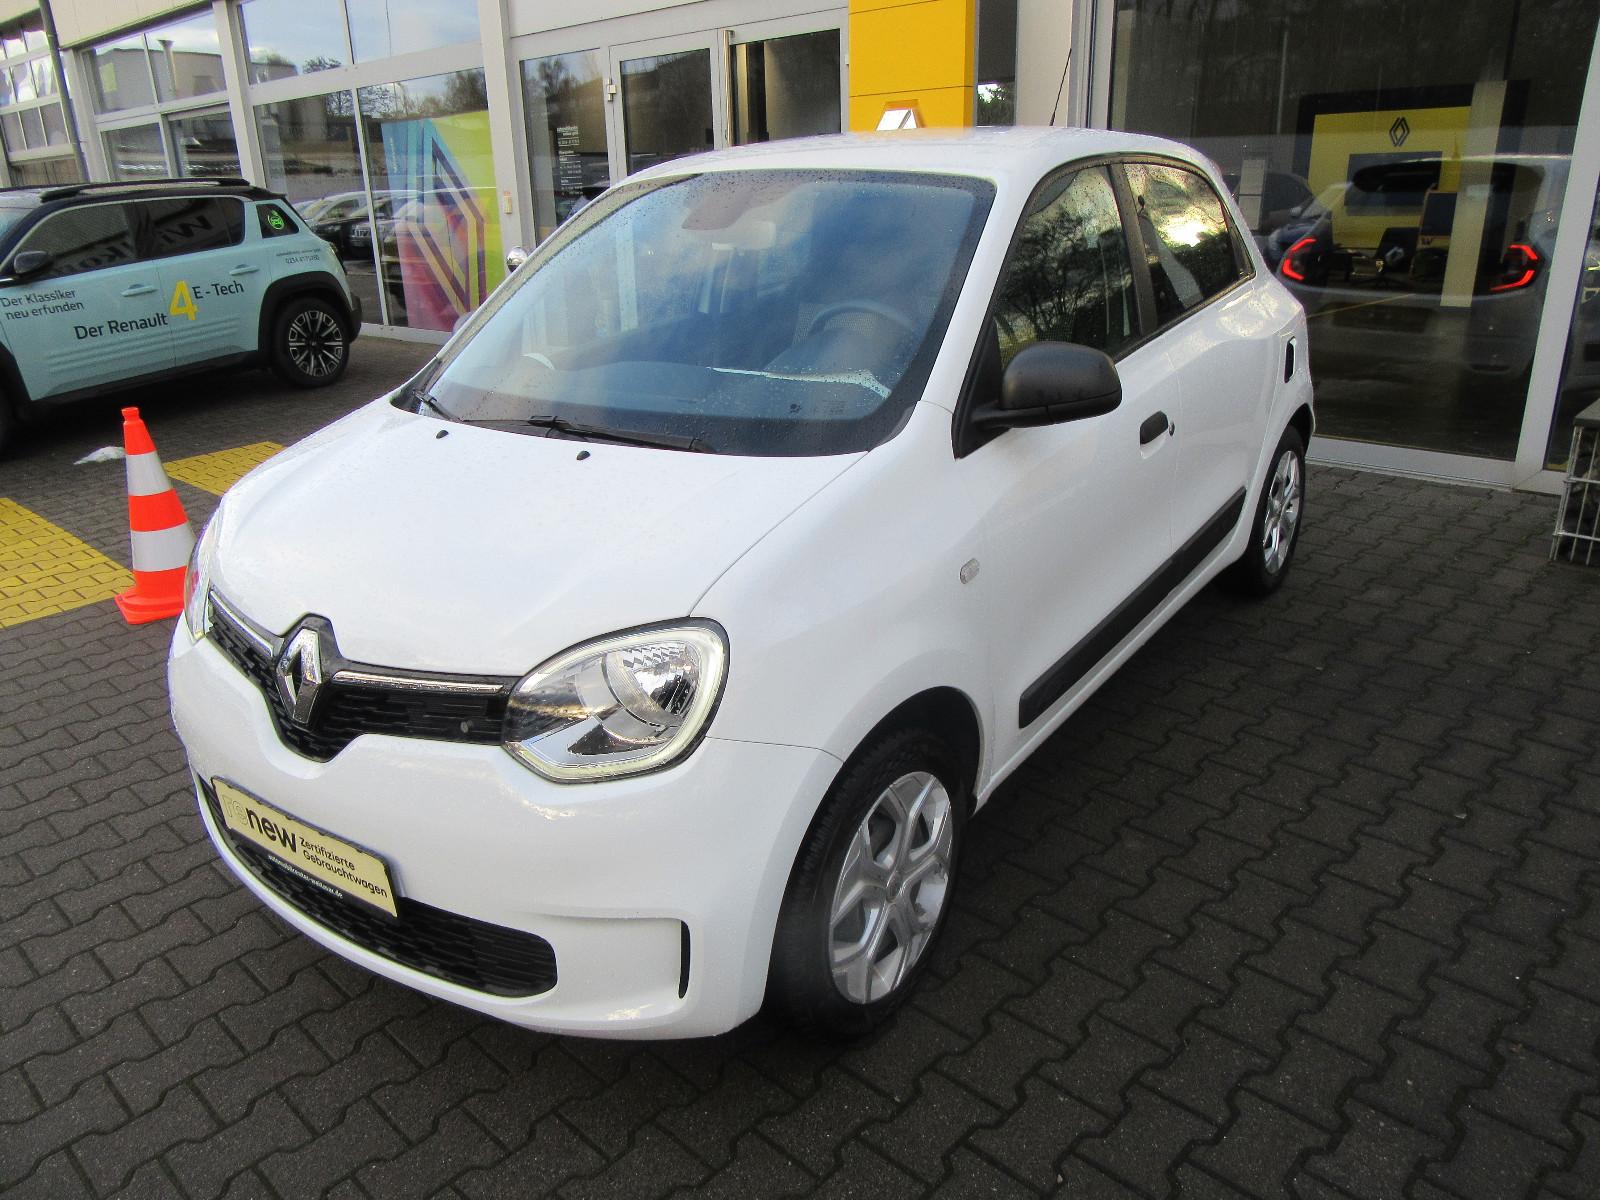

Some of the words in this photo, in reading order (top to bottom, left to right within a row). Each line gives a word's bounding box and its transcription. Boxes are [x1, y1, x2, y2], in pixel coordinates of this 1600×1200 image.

[0, 297, 23, 307] Der
[25, 290, 76, 304] Klassiker
[6, 310, 29, 320] neu
[31, 302, 85, 316] erfunden
[74, 325, 104, 340] Der
[107, 312, 168, 334] Renault
[169, 280, 198, 321] 4
[299, 836, 355, 871] Zertifizierte
[303, 849, 387, 898] Gebrauchtwagen
